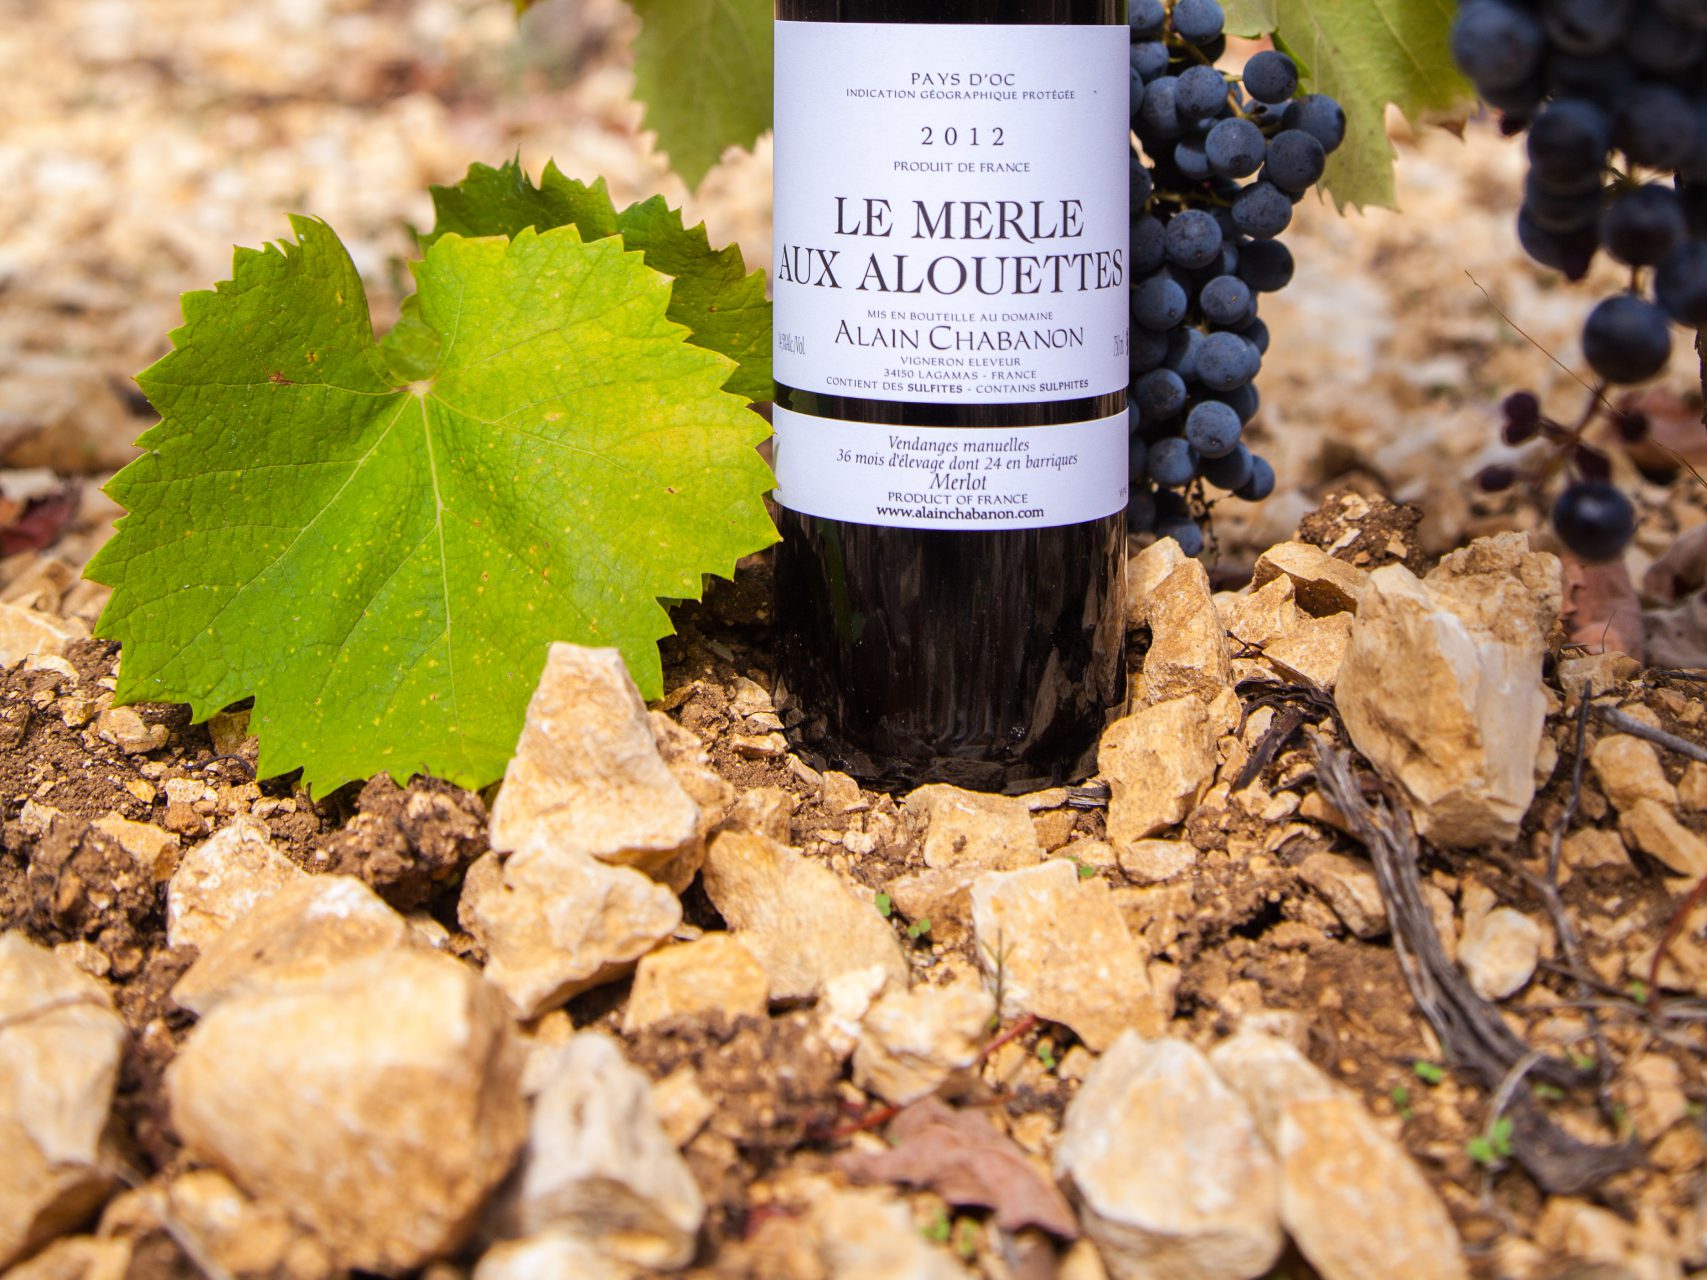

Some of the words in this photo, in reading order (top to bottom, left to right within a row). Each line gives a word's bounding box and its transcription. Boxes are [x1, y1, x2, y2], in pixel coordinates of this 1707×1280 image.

[911, 72, 961, 86] PAYS
[969, 72, 1016, 87] D'OC
[846, 88, 916, 99] INDICATION
[919, 88, 1018, 102] GÉOGRAPHIQUE
[1021, 88, 1076, 101] PROTÉGÉE
[920, 126, 1005, 147] 2012
[893, 160, 954, 173] PRODUIT
[957, 162, 976, 173] DE
[979, 161, 1031, 174] FRANCE
[833, 196, 894, 238] LE
[910, 199, 1085, 245] MERLE
[777, 243, 843, 289] AUX
[855, 248, 1123, 296] ALOUETTES
[867, 309, 887, 320] MIS
[890, 310, 906, 321] EN
[909, 311, 976, 323] BOUTEILLE
[979, 312, 998, 323] AU
[1001, 311, 1054, 323] DOMAINE
[834, 317, 921, 350] ALAIN
[928, 324, 1084, 352] CHABANON
[899, 355, 965, 367] VIGNERON
[968, 356, 1022, 368] ELEVEUR
[883, 367, 915, 379] 34150
[918, 369, 979, 381] LAGAMAS
[991, 369, 1037, 381] FRANCE
[825, 375, 879, 390] CONTIENT
[882, 381, 904, 392] DES
[907, 382, 964, 394] SULFITES
[975, 383, 1037, 394] CONTAINS
[1039, 378, 1089, 393] SULPHITES
[888, 434, 959, 458] Vendanges
[963, 436, 1030, 453] manuelles
[836, 448, 852, 463] 36
[855, 451, 885, 467] mois
[888, 452, 945, 475] d'élevage
[948, 455, 980, 471] dont
[983, 456, 1003, 471] 24
[1005, 458, 1021, 471] en
[1025, 452, 1078, 472] barriques
[928, 471, 987, 491] Merlot
[887, 491, 953, 505] PRODUCT
[955, 494, 974, 506] OF
[977, 493, 1029, 506] FRANCE
[875, 503, 1045, 521] www.alainchabanon.com
